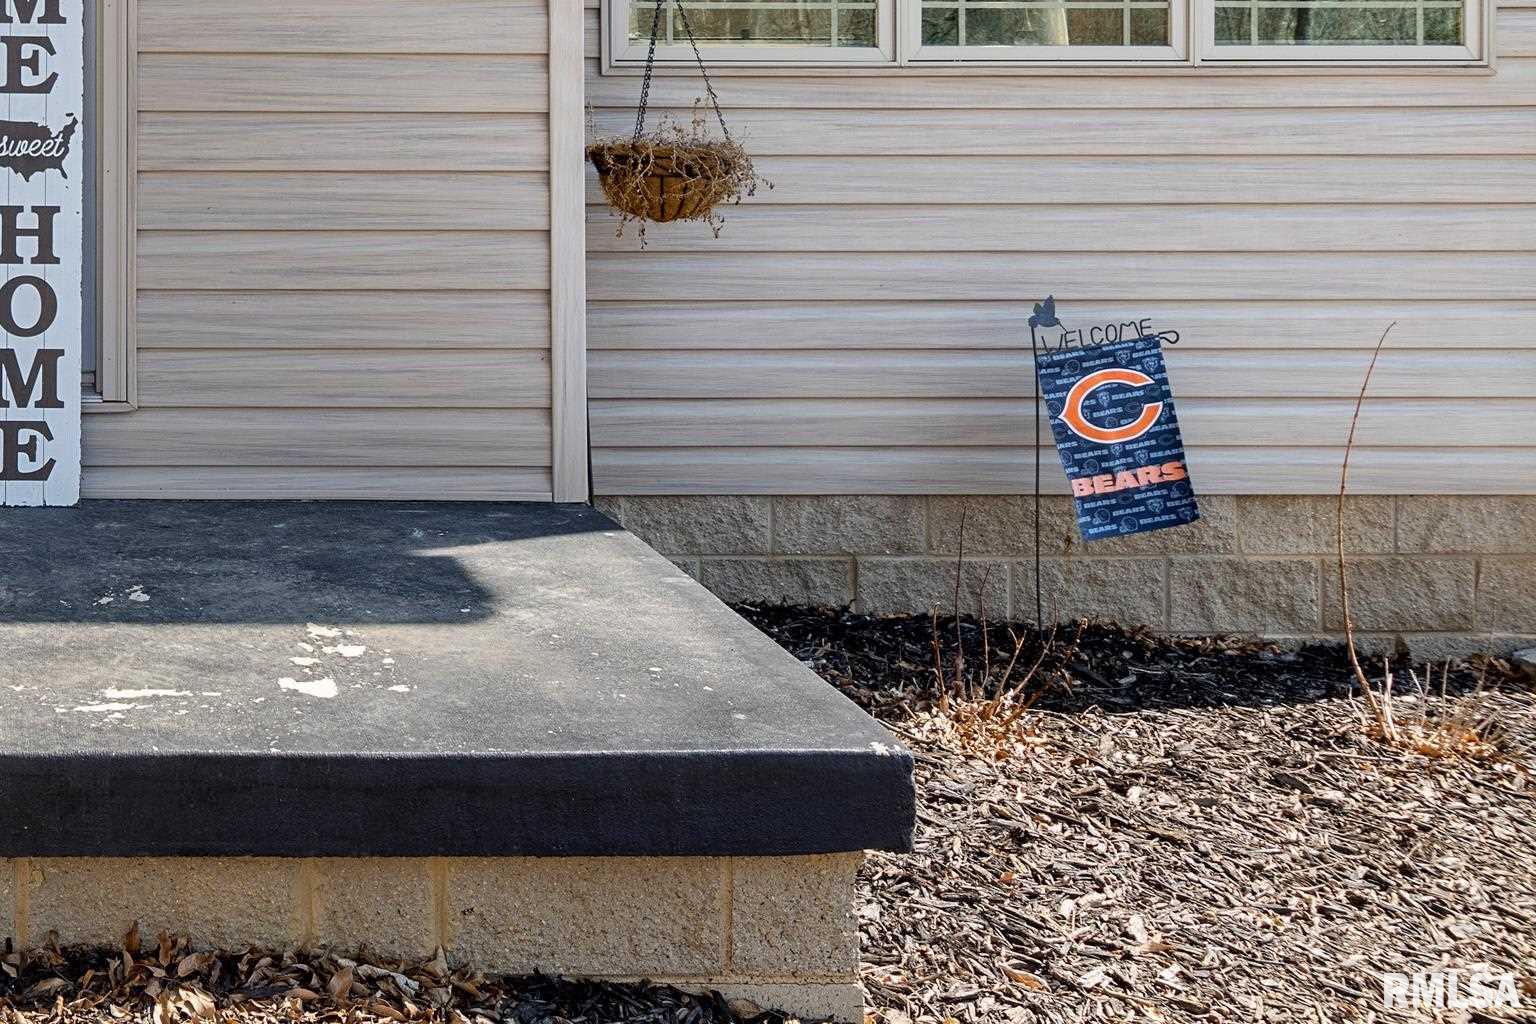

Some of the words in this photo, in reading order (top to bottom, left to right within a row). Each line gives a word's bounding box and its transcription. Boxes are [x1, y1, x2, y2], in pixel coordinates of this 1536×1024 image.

[1041, 317, 1154, 353] WELCOME
[1058, 368, 1163, 444] C
[1071, 460, 1186, 498] BEARS
